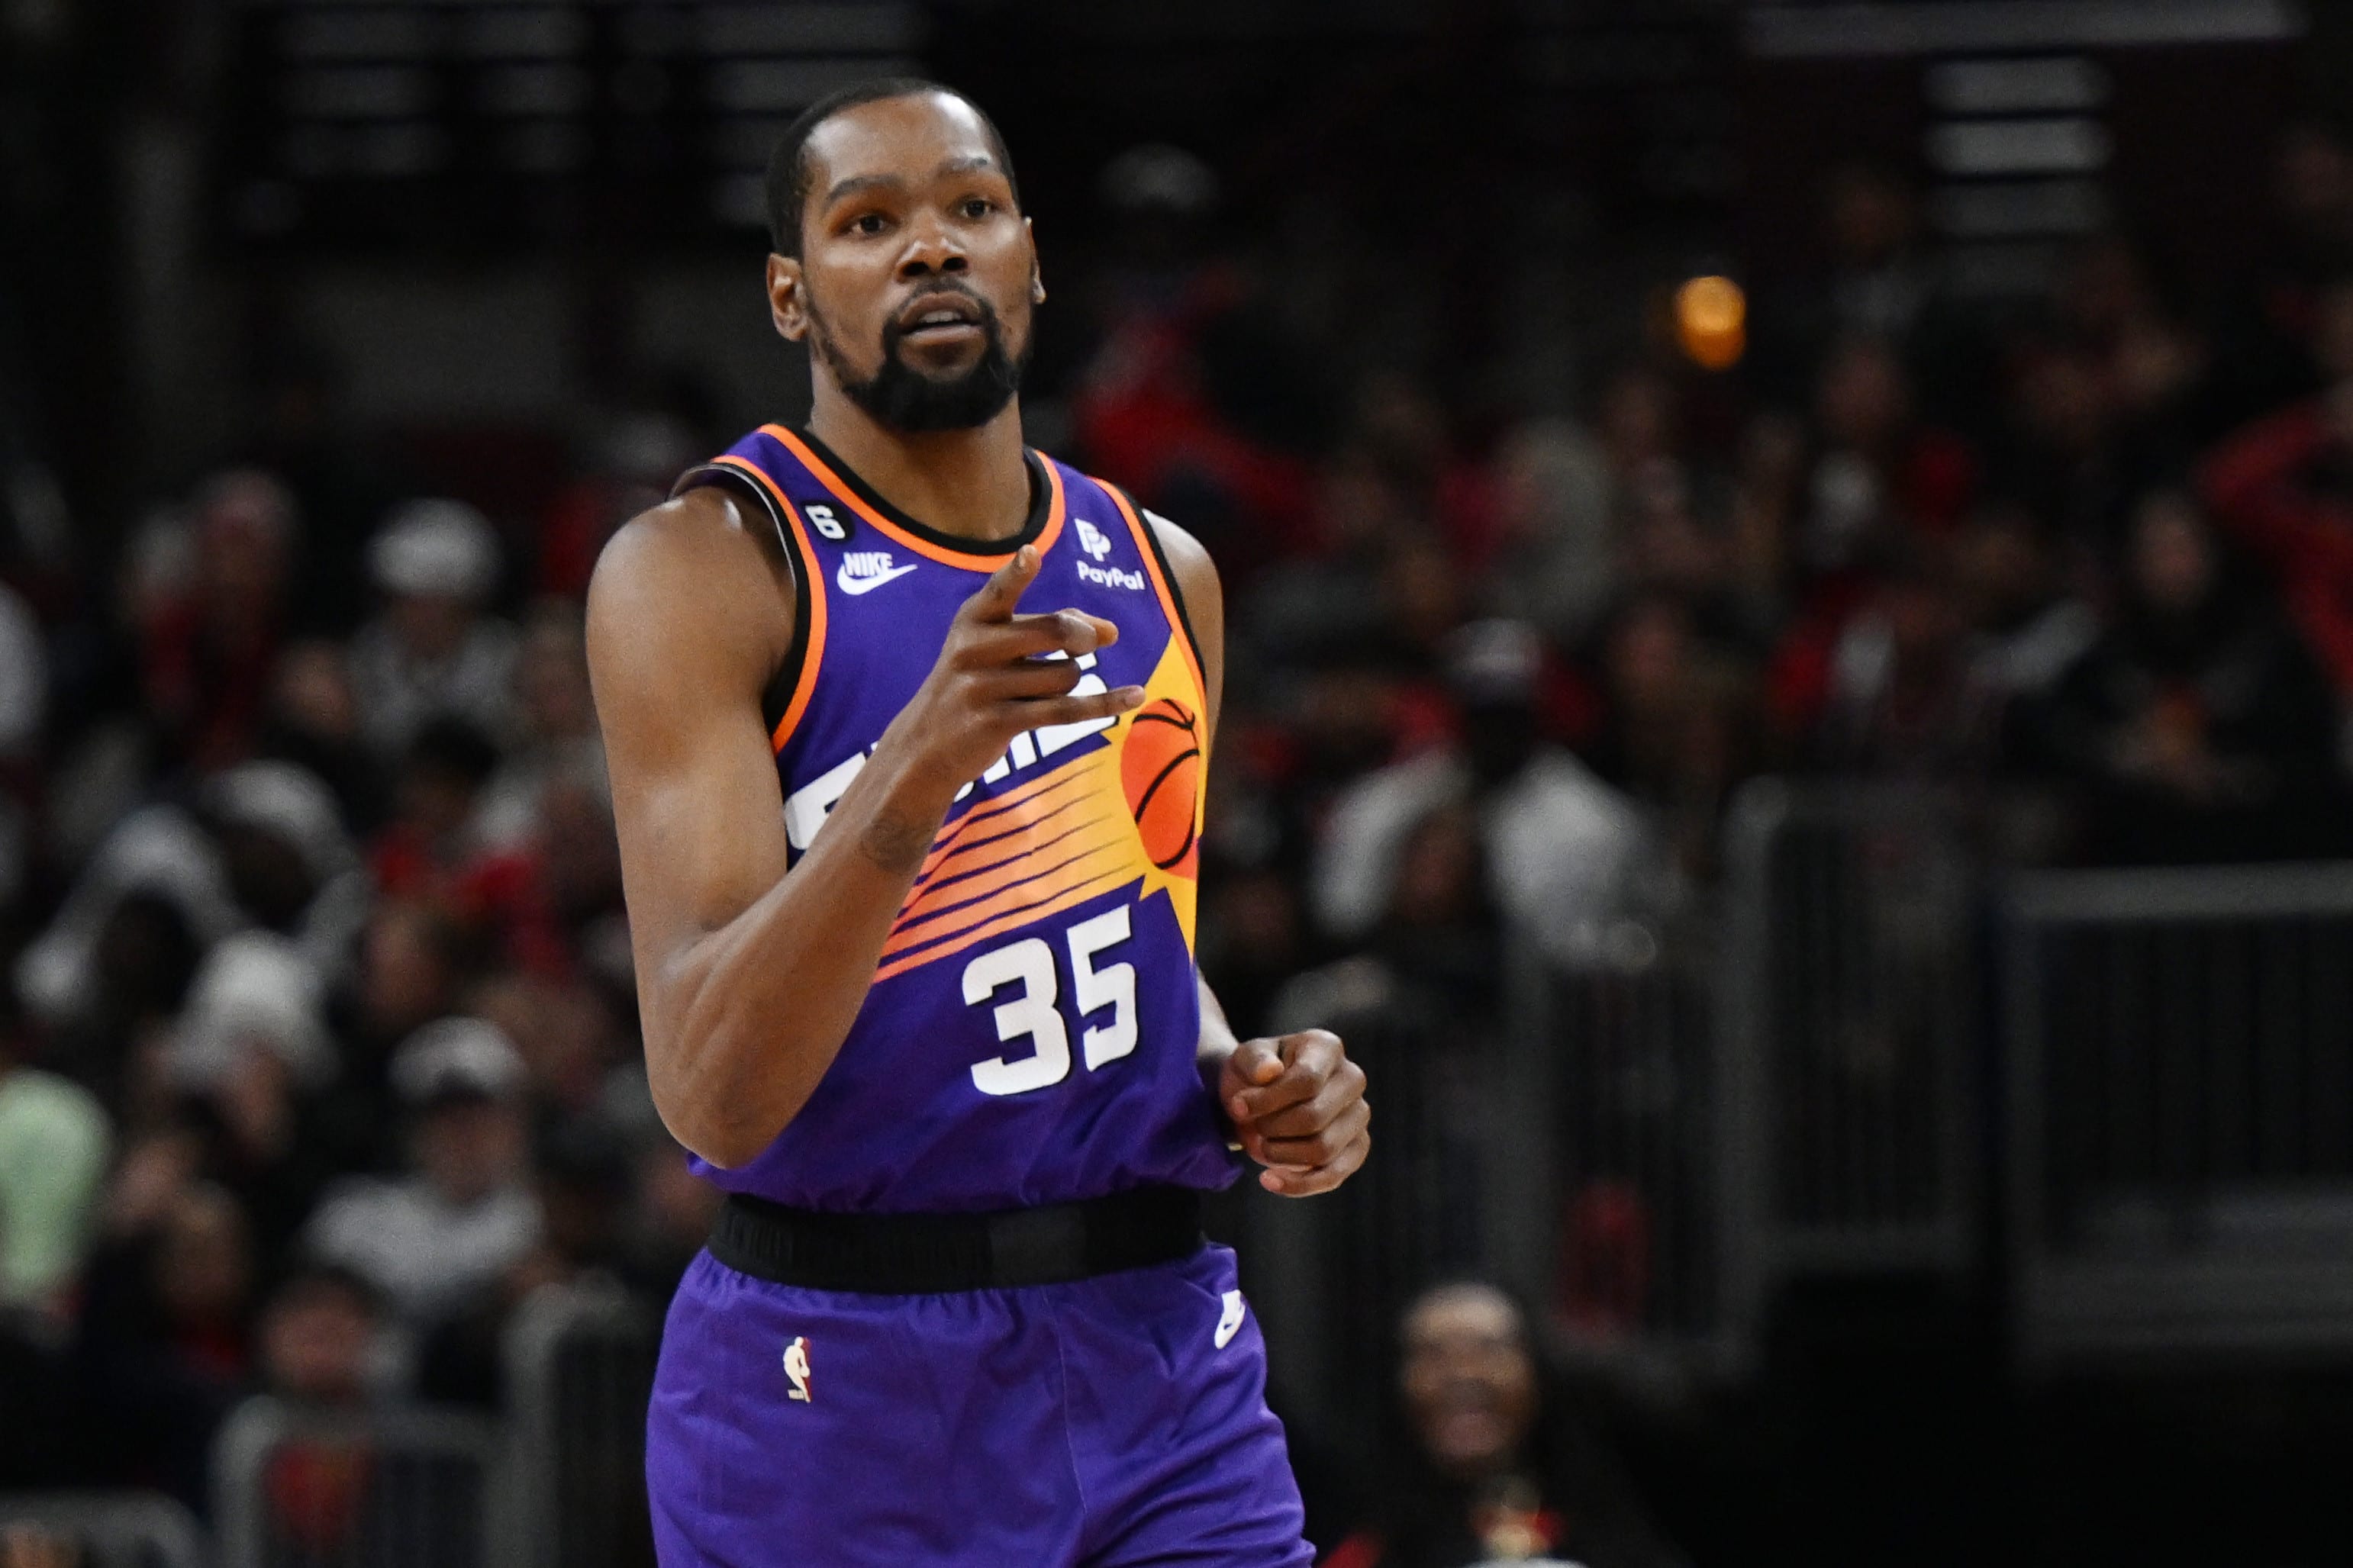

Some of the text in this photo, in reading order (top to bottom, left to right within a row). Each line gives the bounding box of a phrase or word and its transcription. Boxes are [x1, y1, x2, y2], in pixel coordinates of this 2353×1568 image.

[805, 505, 846, 539] 6
[843, 552, 893, 577] NIKE
[1076, 560, 1146, 590] PayPal
[962, 904, 1138, 1096] 35
